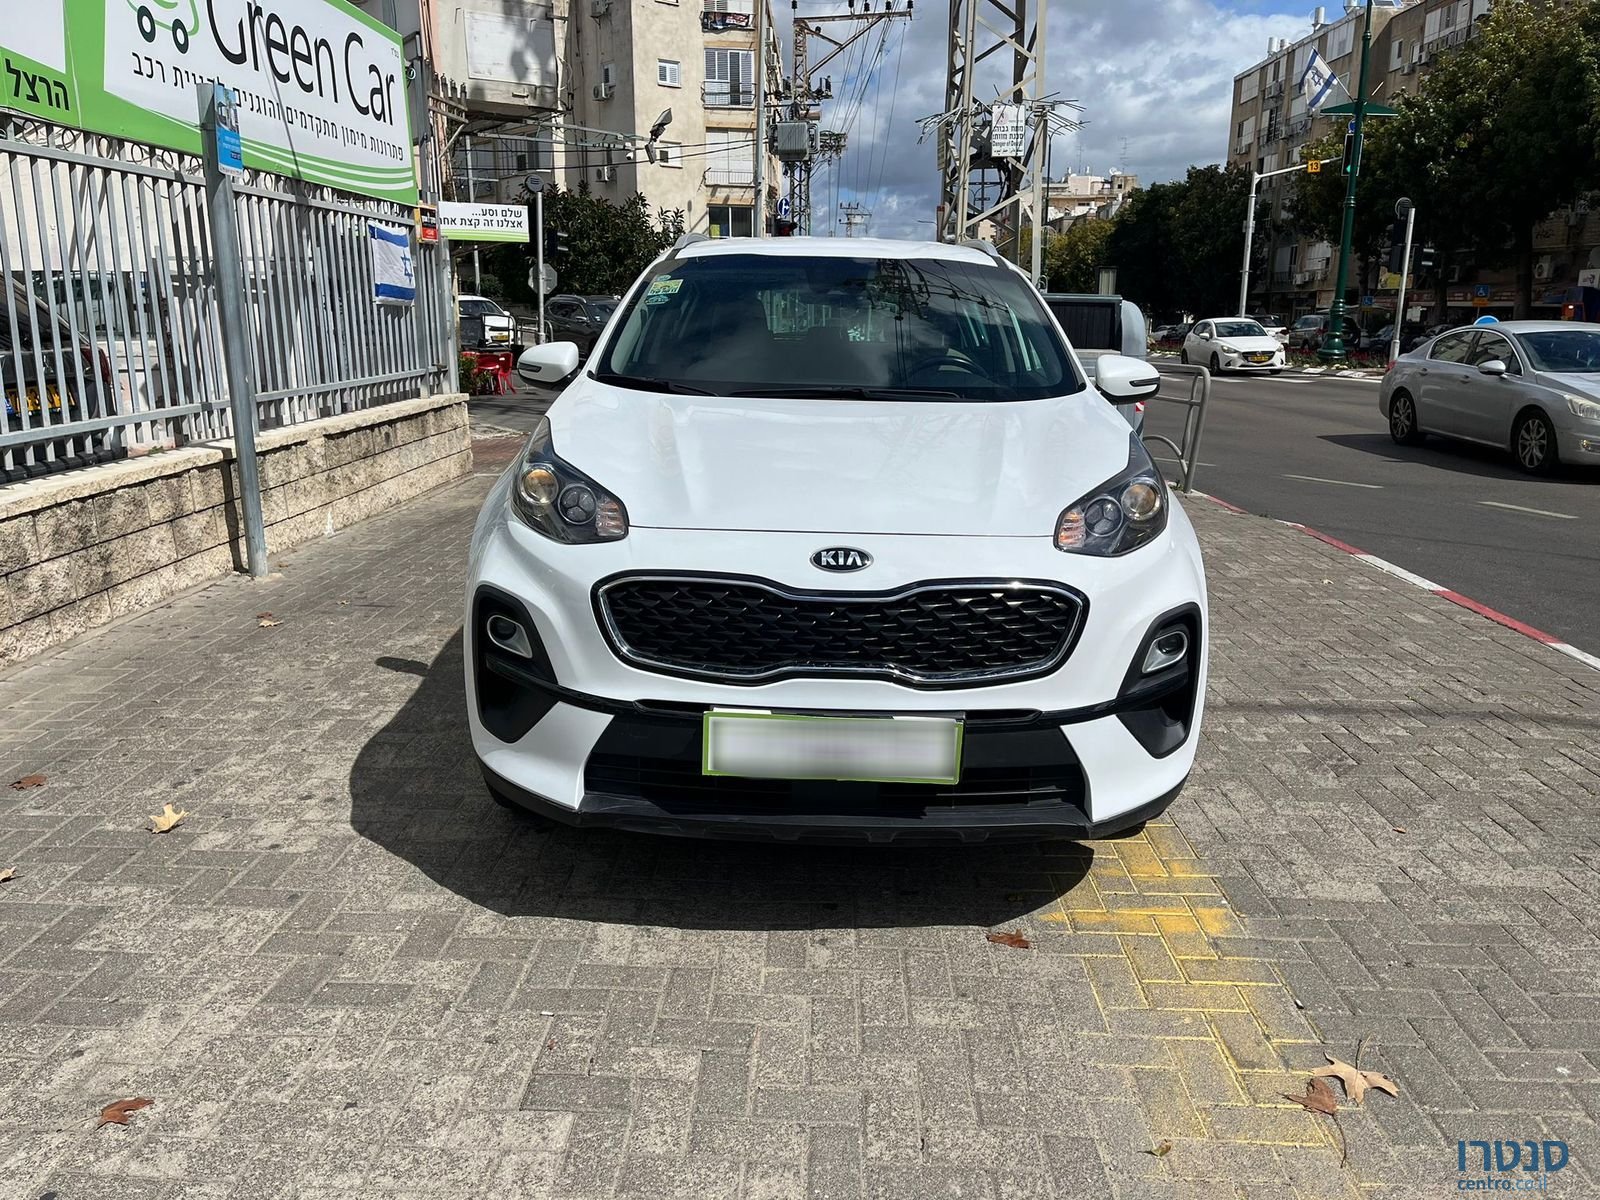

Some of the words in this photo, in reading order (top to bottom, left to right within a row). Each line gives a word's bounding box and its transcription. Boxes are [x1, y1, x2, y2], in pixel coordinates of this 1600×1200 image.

[131, 51, 166, 83] רכב
[206, 0, 339, 104] Green
[344, 32, 395, 126] Car
[5, 57, 70, 111] הרצל
[232, 87, 281, 120] והוגנים
[286, 106, 338, 139] מתקדמים
[341, 125, 368, 149] מימון
[370, 135, 404, 161] פתרונות
[1310, 161, 1319, 171] 13
[459, 217, 480, 229] קצת
[483, 218, 494, 228] זה
[497, 218, 523, 228] אצלנו
[501, 208, 523, 218] שלם
[820, 550, 863, 566] KIA
